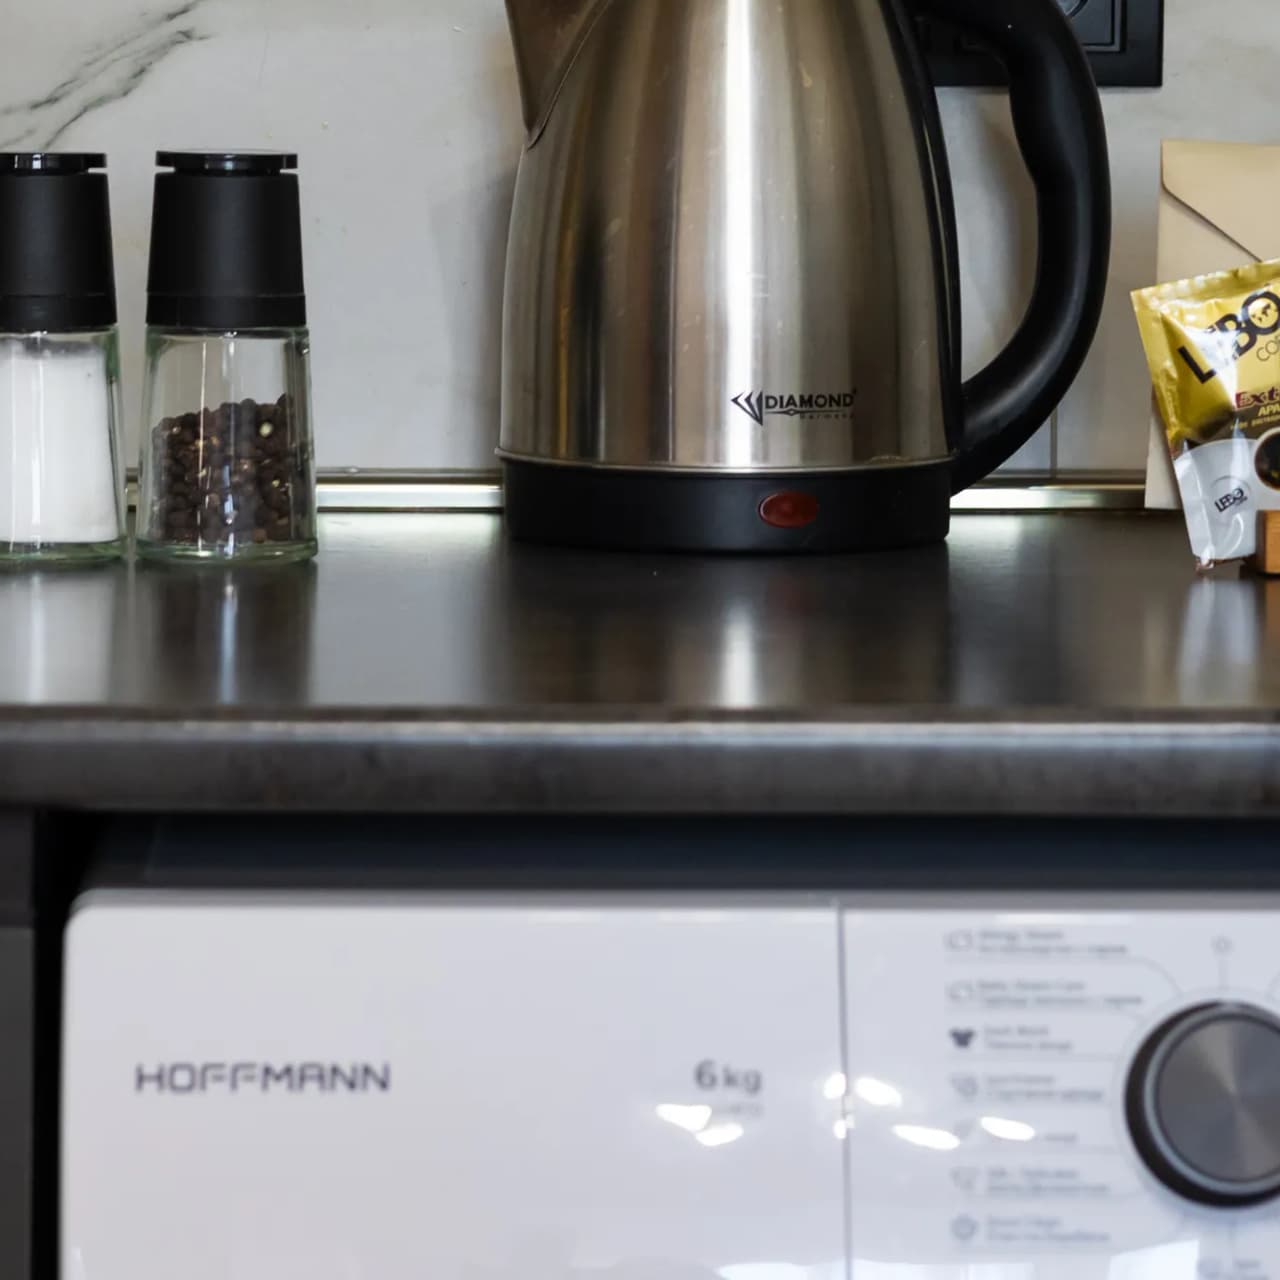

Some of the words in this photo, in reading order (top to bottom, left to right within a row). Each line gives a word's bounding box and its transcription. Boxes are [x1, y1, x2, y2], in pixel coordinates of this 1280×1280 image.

[764, 393, 855, 409] DIAMOND
[134, 1061, 392, 1094] HOFFMANN
[694, 1058, 718, 1092] 6
[722, 1062, 763, 1098] kg
